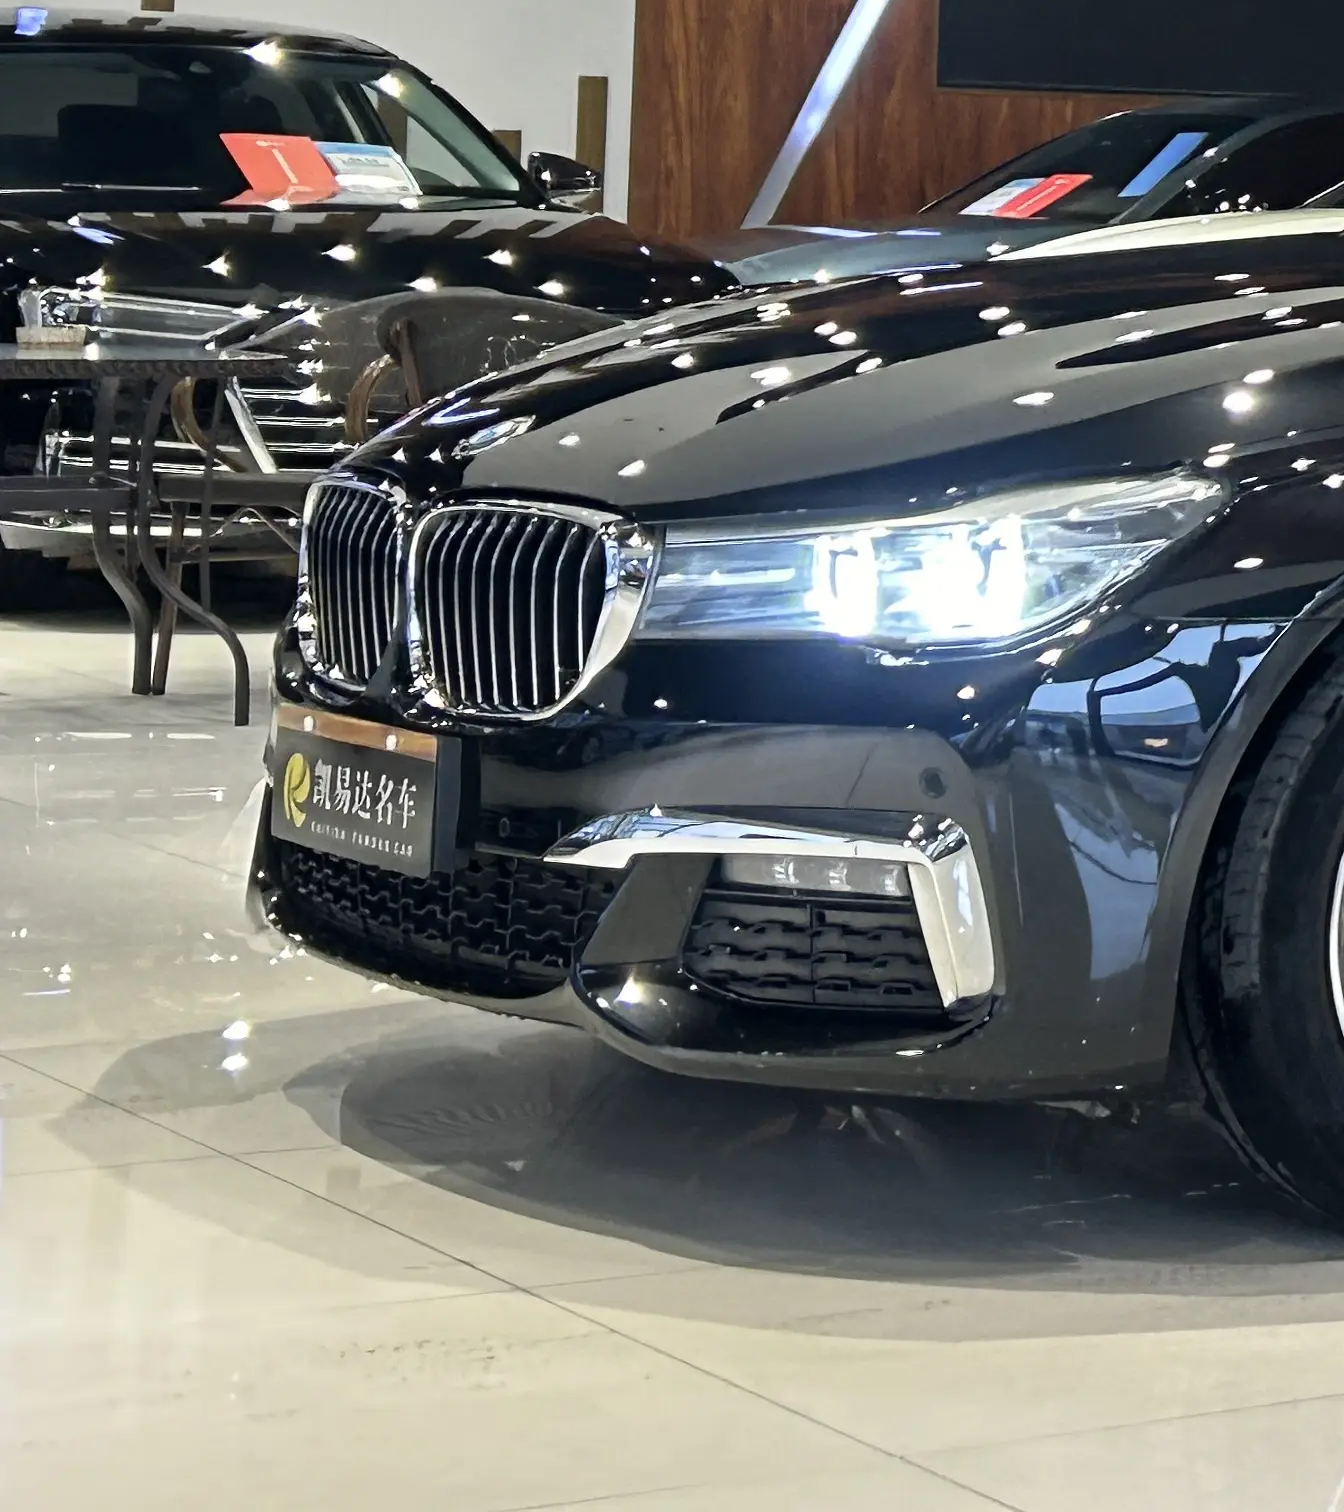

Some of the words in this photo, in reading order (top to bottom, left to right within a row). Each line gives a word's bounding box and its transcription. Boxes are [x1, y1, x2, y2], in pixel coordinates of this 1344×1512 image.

[312, 758, 417, 829] 凯易达名车
